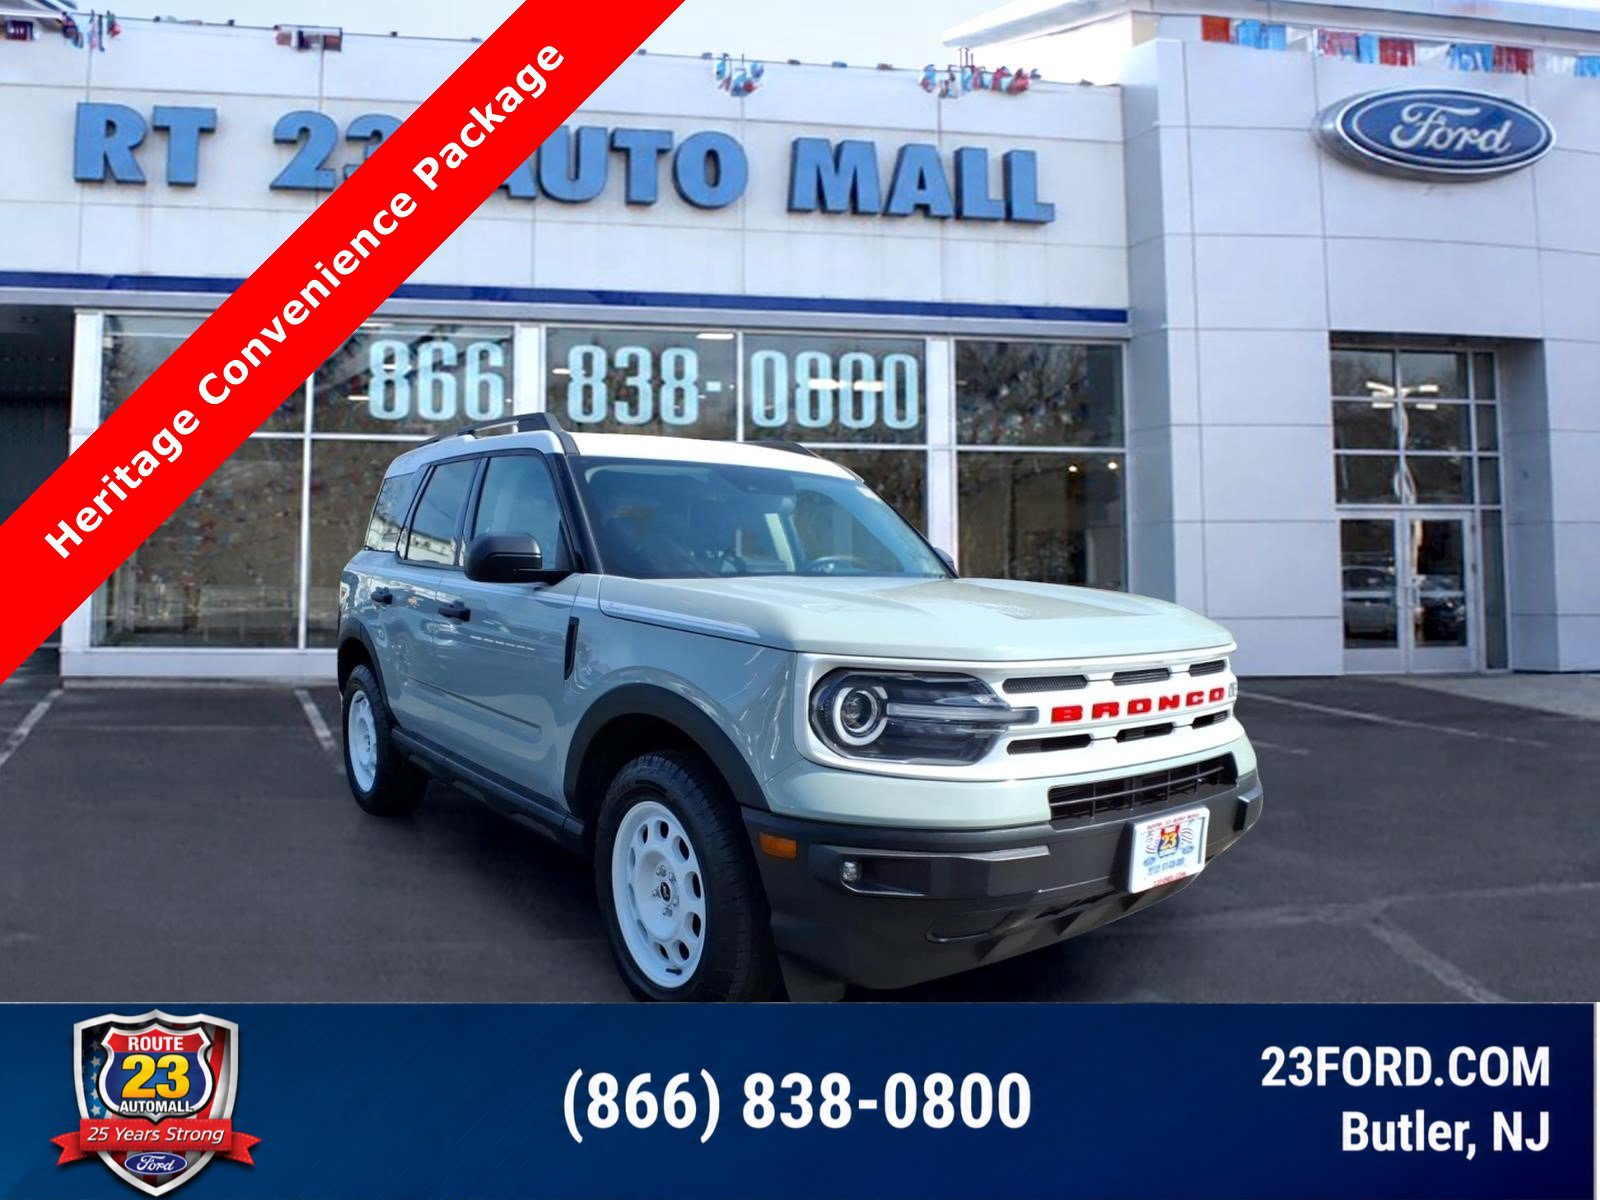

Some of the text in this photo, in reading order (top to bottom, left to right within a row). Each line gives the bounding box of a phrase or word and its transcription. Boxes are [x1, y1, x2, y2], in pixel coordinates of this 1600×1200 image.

[1389, 102, 1512, 153] Ford
[74, 101, 217, 187] RT
[787, 137, 1056, 224] MALL
[369, 340, 504, 421] 866
[1051, 687, 1225, 724] BRONCO
